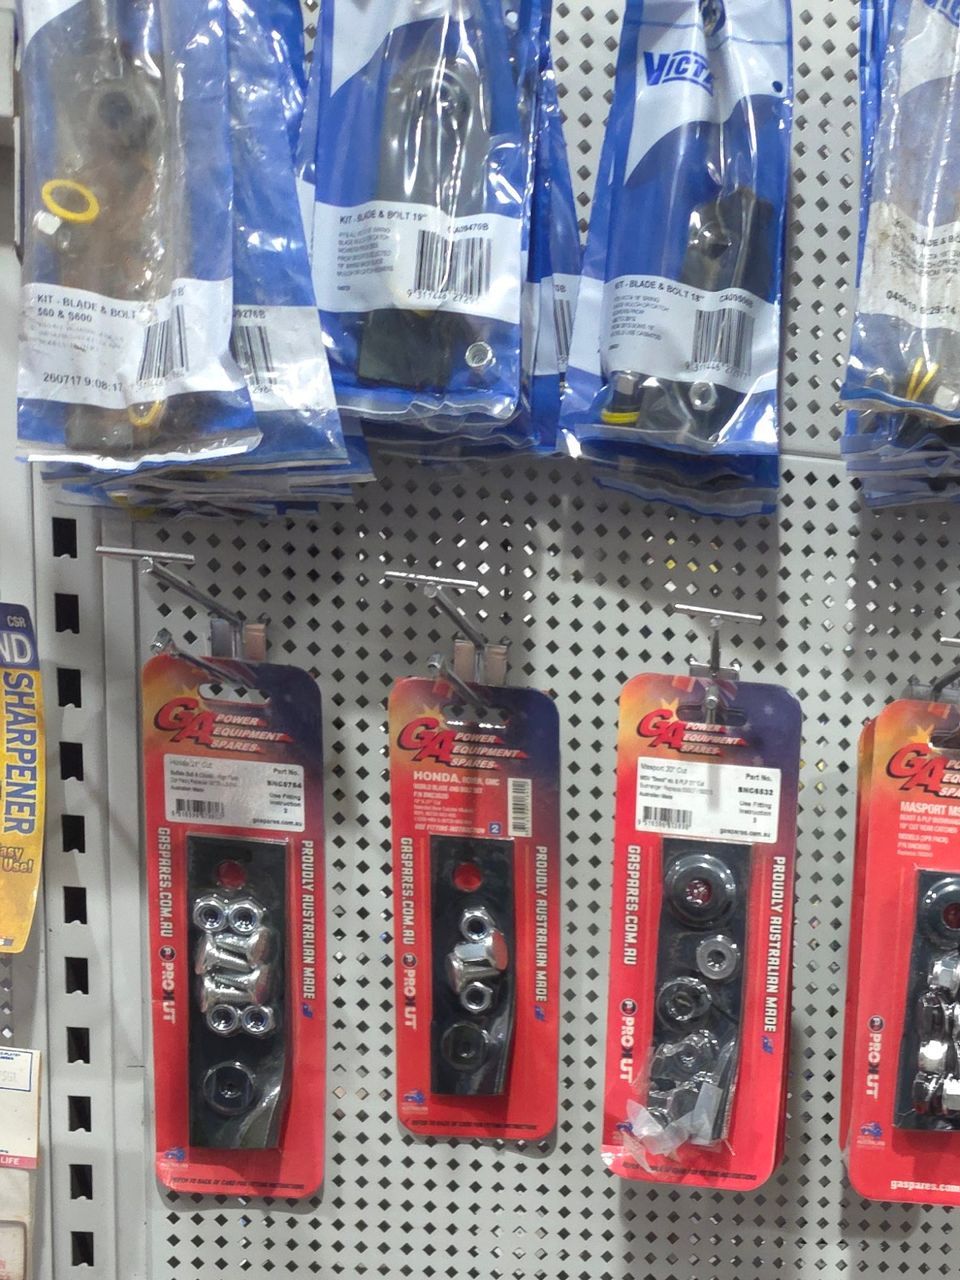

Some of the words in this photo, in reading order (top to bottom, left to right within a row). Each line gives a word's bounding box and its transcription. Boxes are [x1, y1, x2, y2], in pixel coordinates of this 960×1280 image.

[153, 697, 216, 744] GA
[213, 726, 284, 741] EQUIPMENT
[215, 713, 260, 725] POWER
[397, 717, 457, 763] GA
[637, 709, 687, 750] GA
[2, 670, 38, 836] SHARPENER
[210, 740, 259, 752] SPARES
[886, 743, 947, 796] GA
[491, 825, 500, 834] 2
[900, 801, 946, 815] MASPORT
[157, 827, 174, 939] GASPARES.COM.AU
[302, 840, 315, 885] PROUDLY
[535, 846, 549, 896] PROUDLY
[770, 856, 787, 915] PROUDLY
[401, 838, 416, 945] GASPARES.COM.AU
[623, 845, 641, 966] GASPARES.COM.AU
[302, 888, 316, 960] AUSTRALIAN
[535, 897, 549, 969] AUSTRALIAN
[766, 916, 784, 995] AUSTRALIAN
[302, 962, 316, 1000] MADE
[535, 970, 548, 1003] MADE
[763, 996, 778, 1033] MADE
